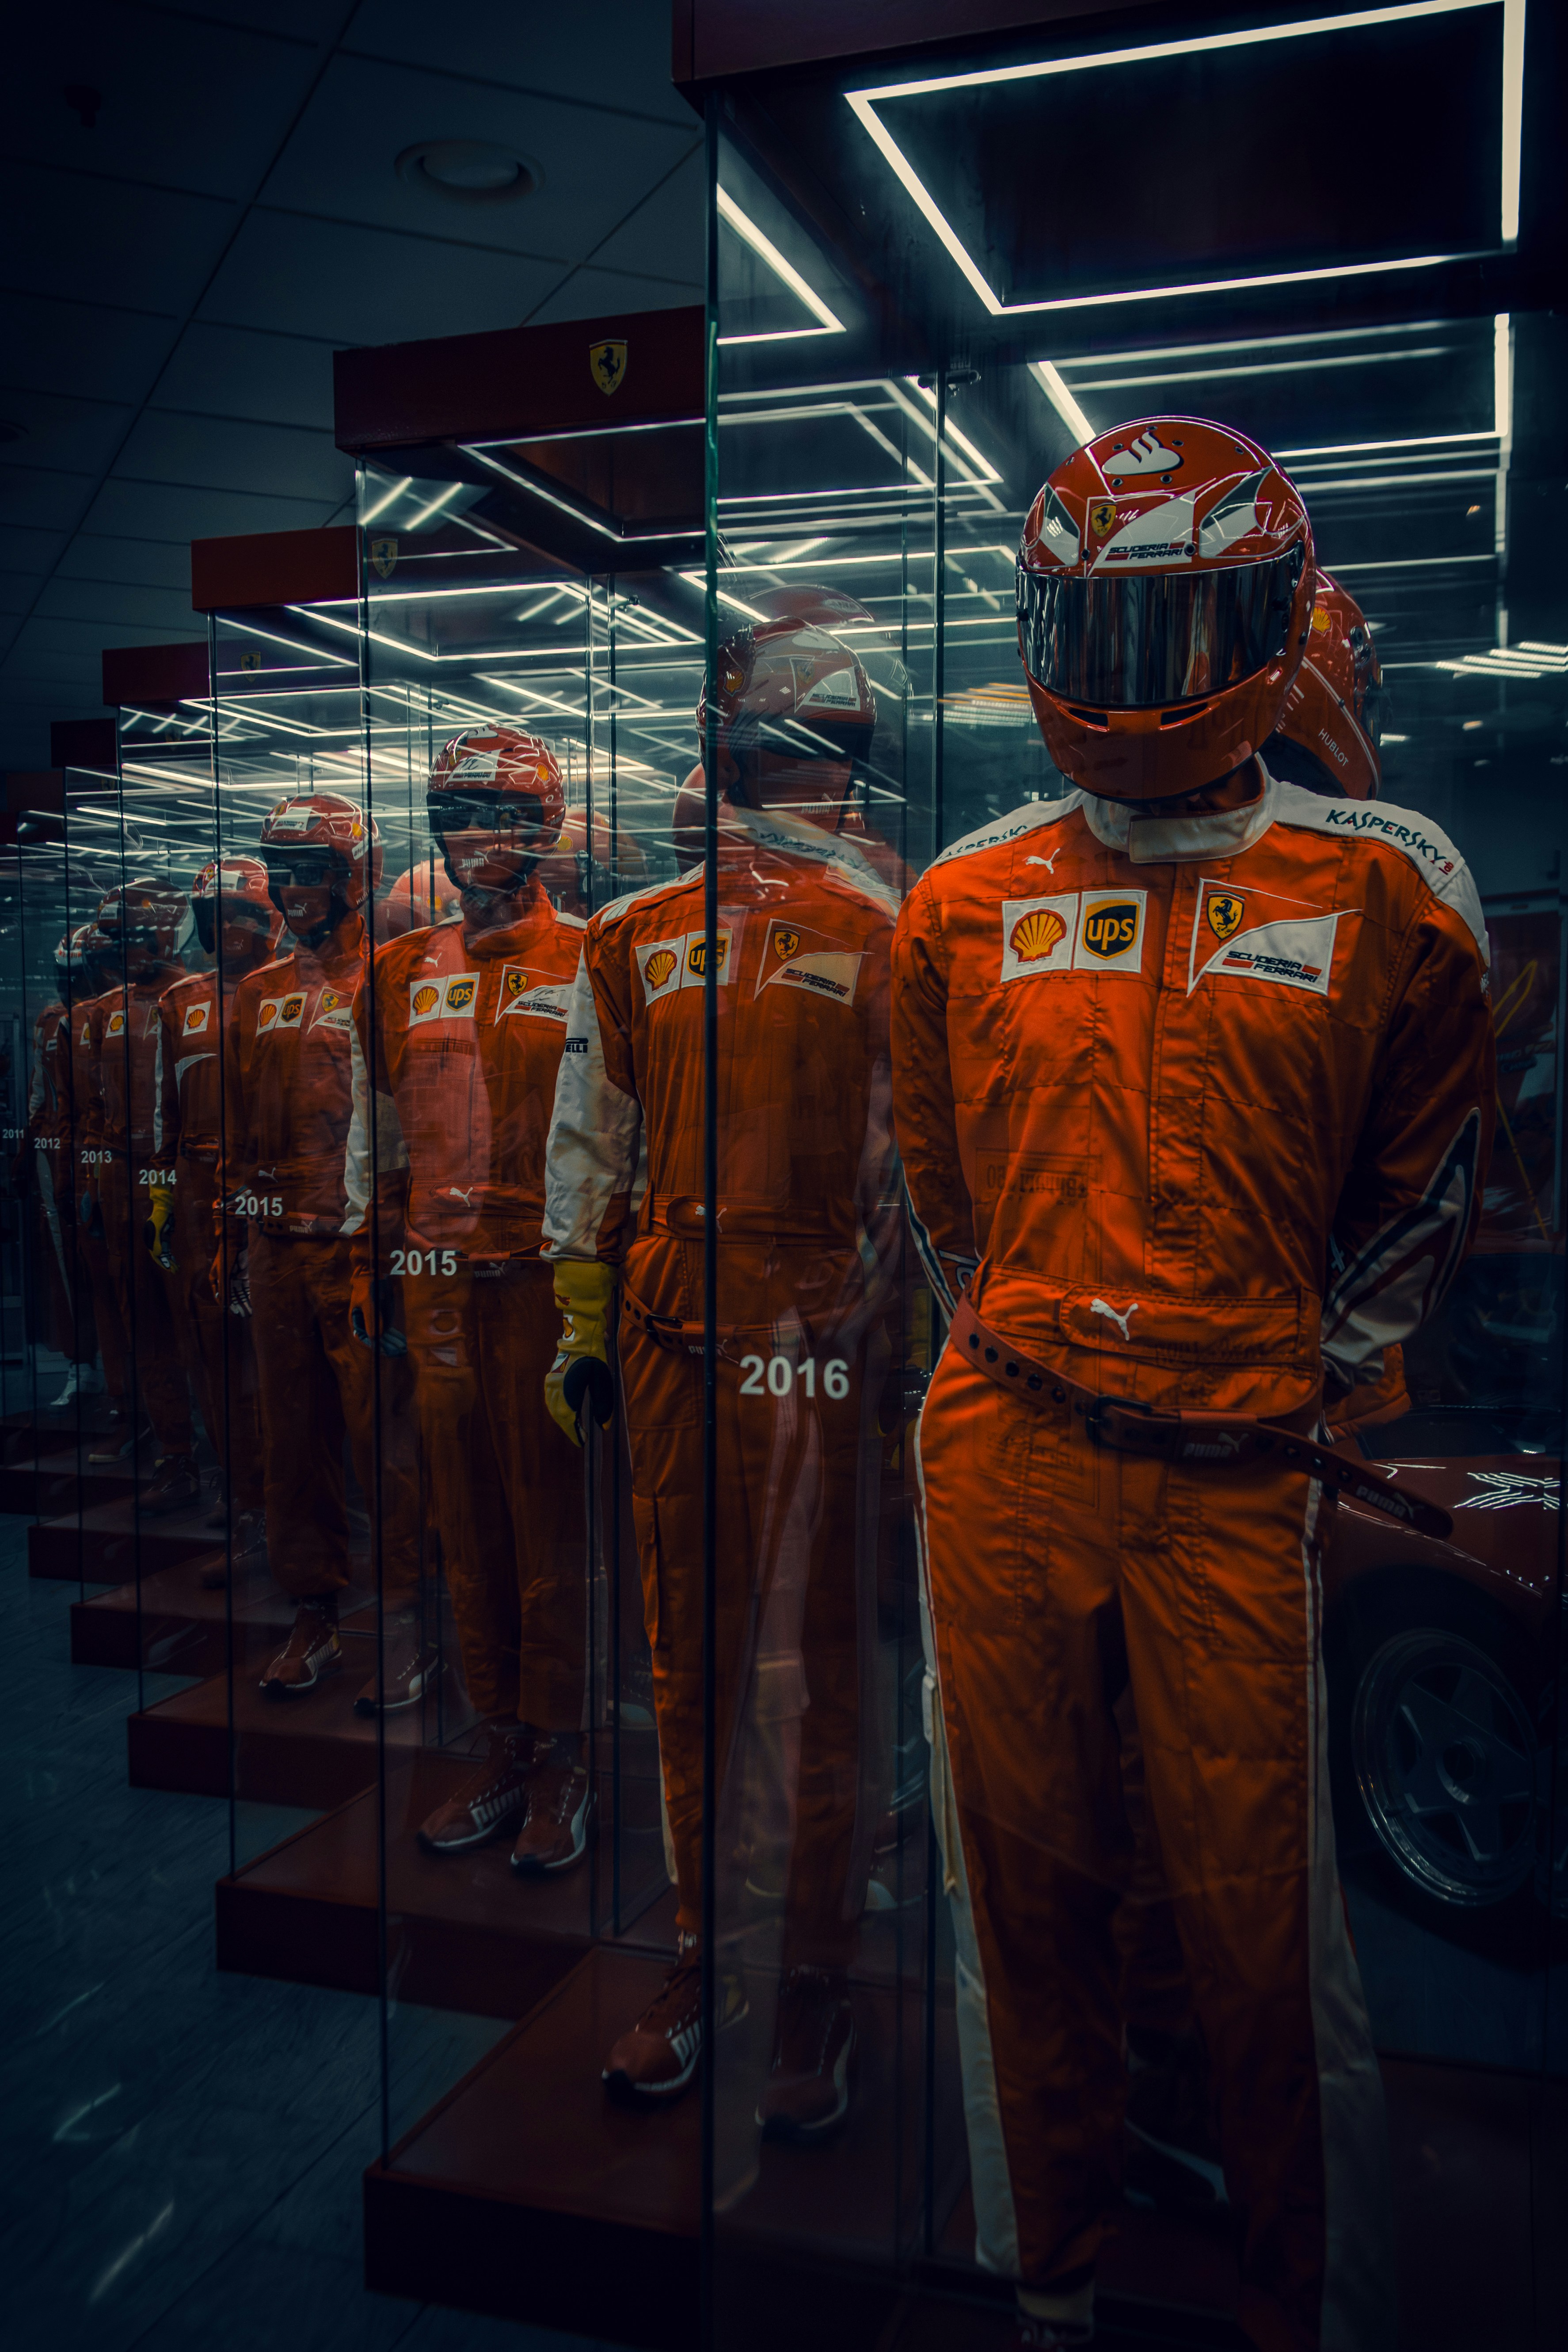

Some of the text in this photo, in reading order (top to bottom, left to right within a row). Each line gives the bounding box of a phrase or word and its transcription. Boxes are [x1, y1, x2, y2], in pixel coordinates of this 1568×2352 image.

[1108, 543, 1168, 554] SCUDERIA
[1129, 548, 1183, 559] FERRARI
[1318, 728, 1349, 767] HUBLOT
[1326, 809, 1447, 861] KASPERSKY
[1088, 918, 1134, 950] ups
[1226, 951, 1302, 970] SCUDERIA
[785, 968, 837, 987] SCUDERIA
[1254, 963, 1318, 983] FERRARI
[448, 988, 472, 1006] ups
[802, 978, 846, 997] FERRARI
[517, 1001, 558, 1010] SCUDERIA
[531, 1007, 566, 1017] FERRARI
[2, 1129, 24, 1139] 2011
[34, 1138, 61, 1149] 2012
[81, 1150, 112, 1164] 2013
[139, 1169, 177, 1185] 2014
[235, 1196, 283, 1216] 2015
[390, 1250, 457, 1276] 2015
[739, 1355, 850, 1400] 2016
[1183, 1442, 1233, 1458] PUMA
[1355, 1484, 1407, 1518] PUMA
